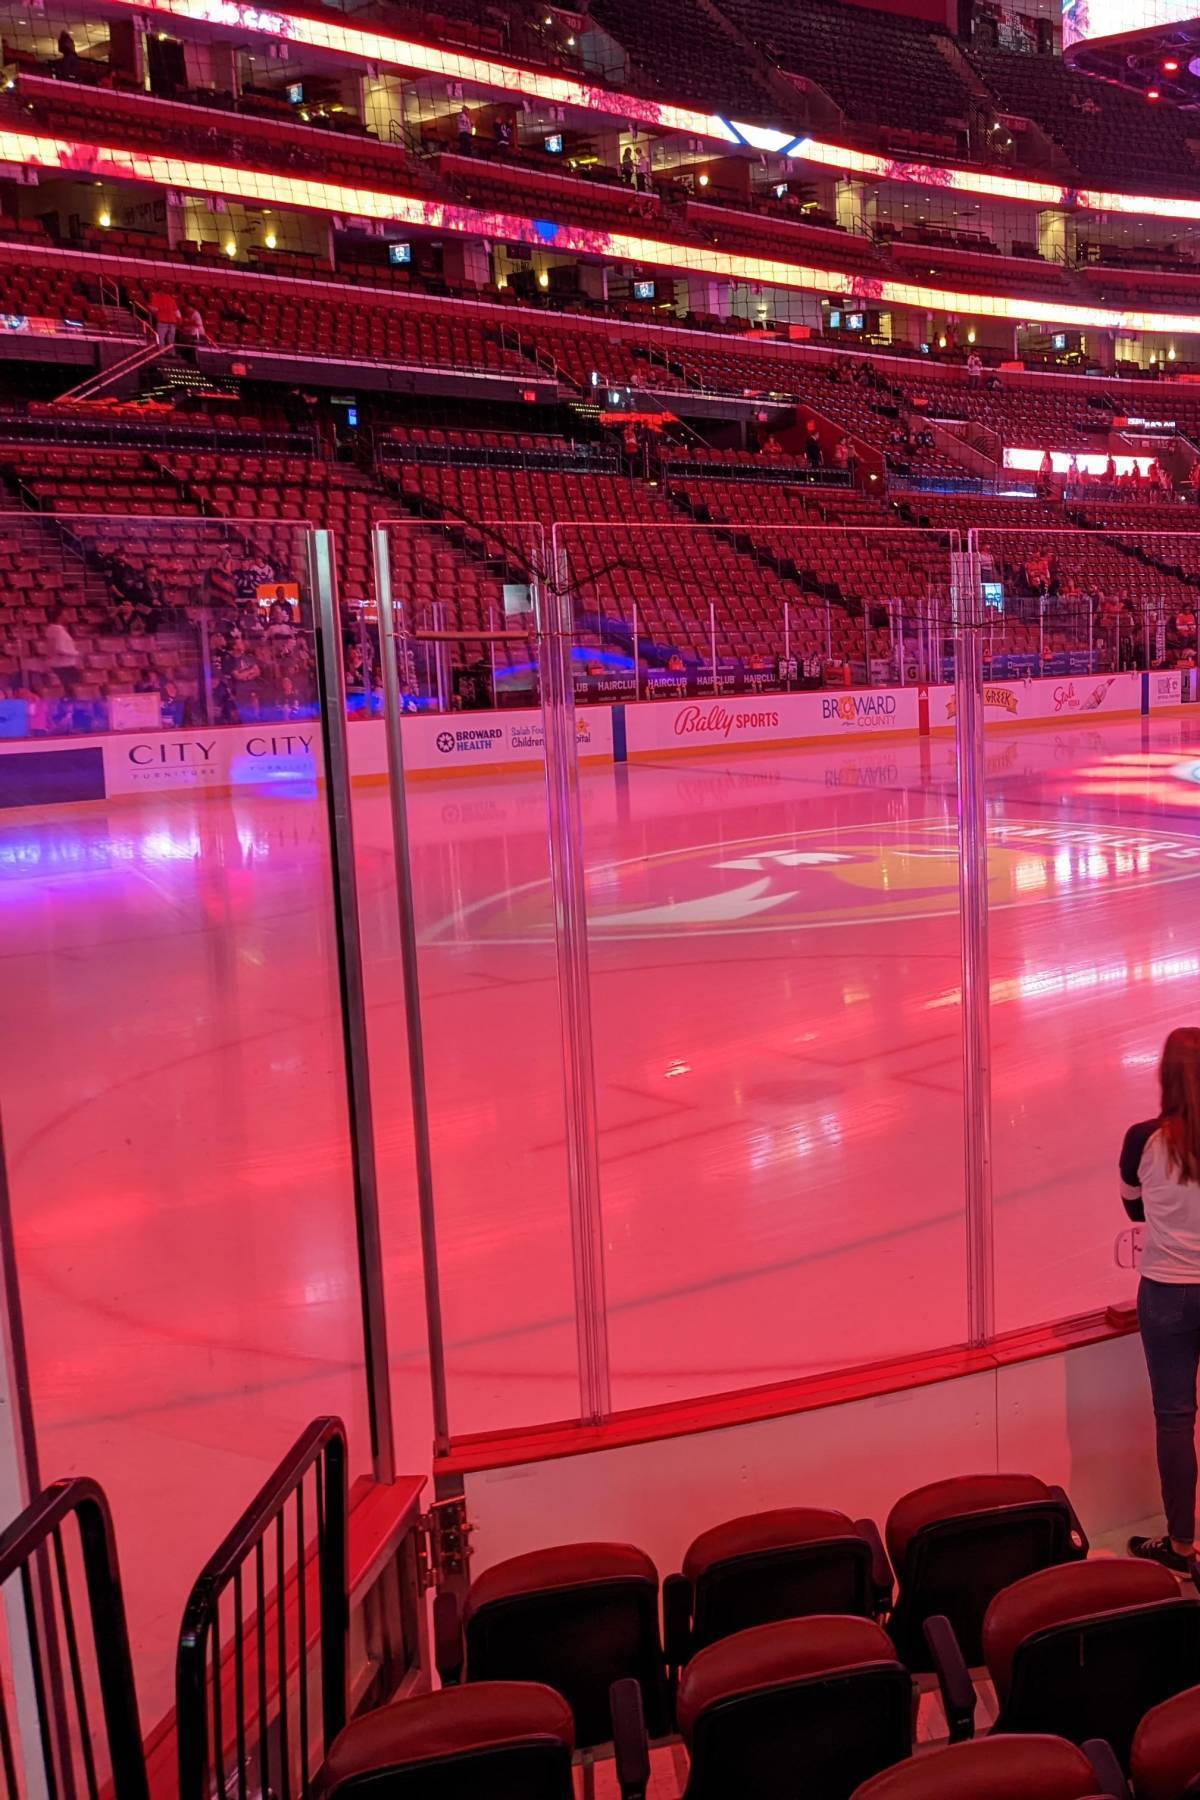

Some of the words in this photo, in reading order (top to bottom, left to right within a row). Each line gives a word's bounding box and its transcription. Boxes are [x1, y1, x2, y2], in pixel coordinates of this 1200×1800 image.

[647, 677, 688, 687] HAIRCLUB
[743, 673, 776, 683] HAIRCLU
[822, 695, 896, 719] BROWARD
[674, 705, 735, 738] Bally
[736, 712, 779, 729] SPORTS
[857, 714, 896, 727] COUNTY
[456, 728, 503, 741] BROWARD
[246, 735, 313, 757] CITY
[456, 739, 492, 751] HEALTH
[511, 737, 545, 748] Children
[129, 741, 217, 765] CITY
[133, 768, 216, 780] FURNITURE
